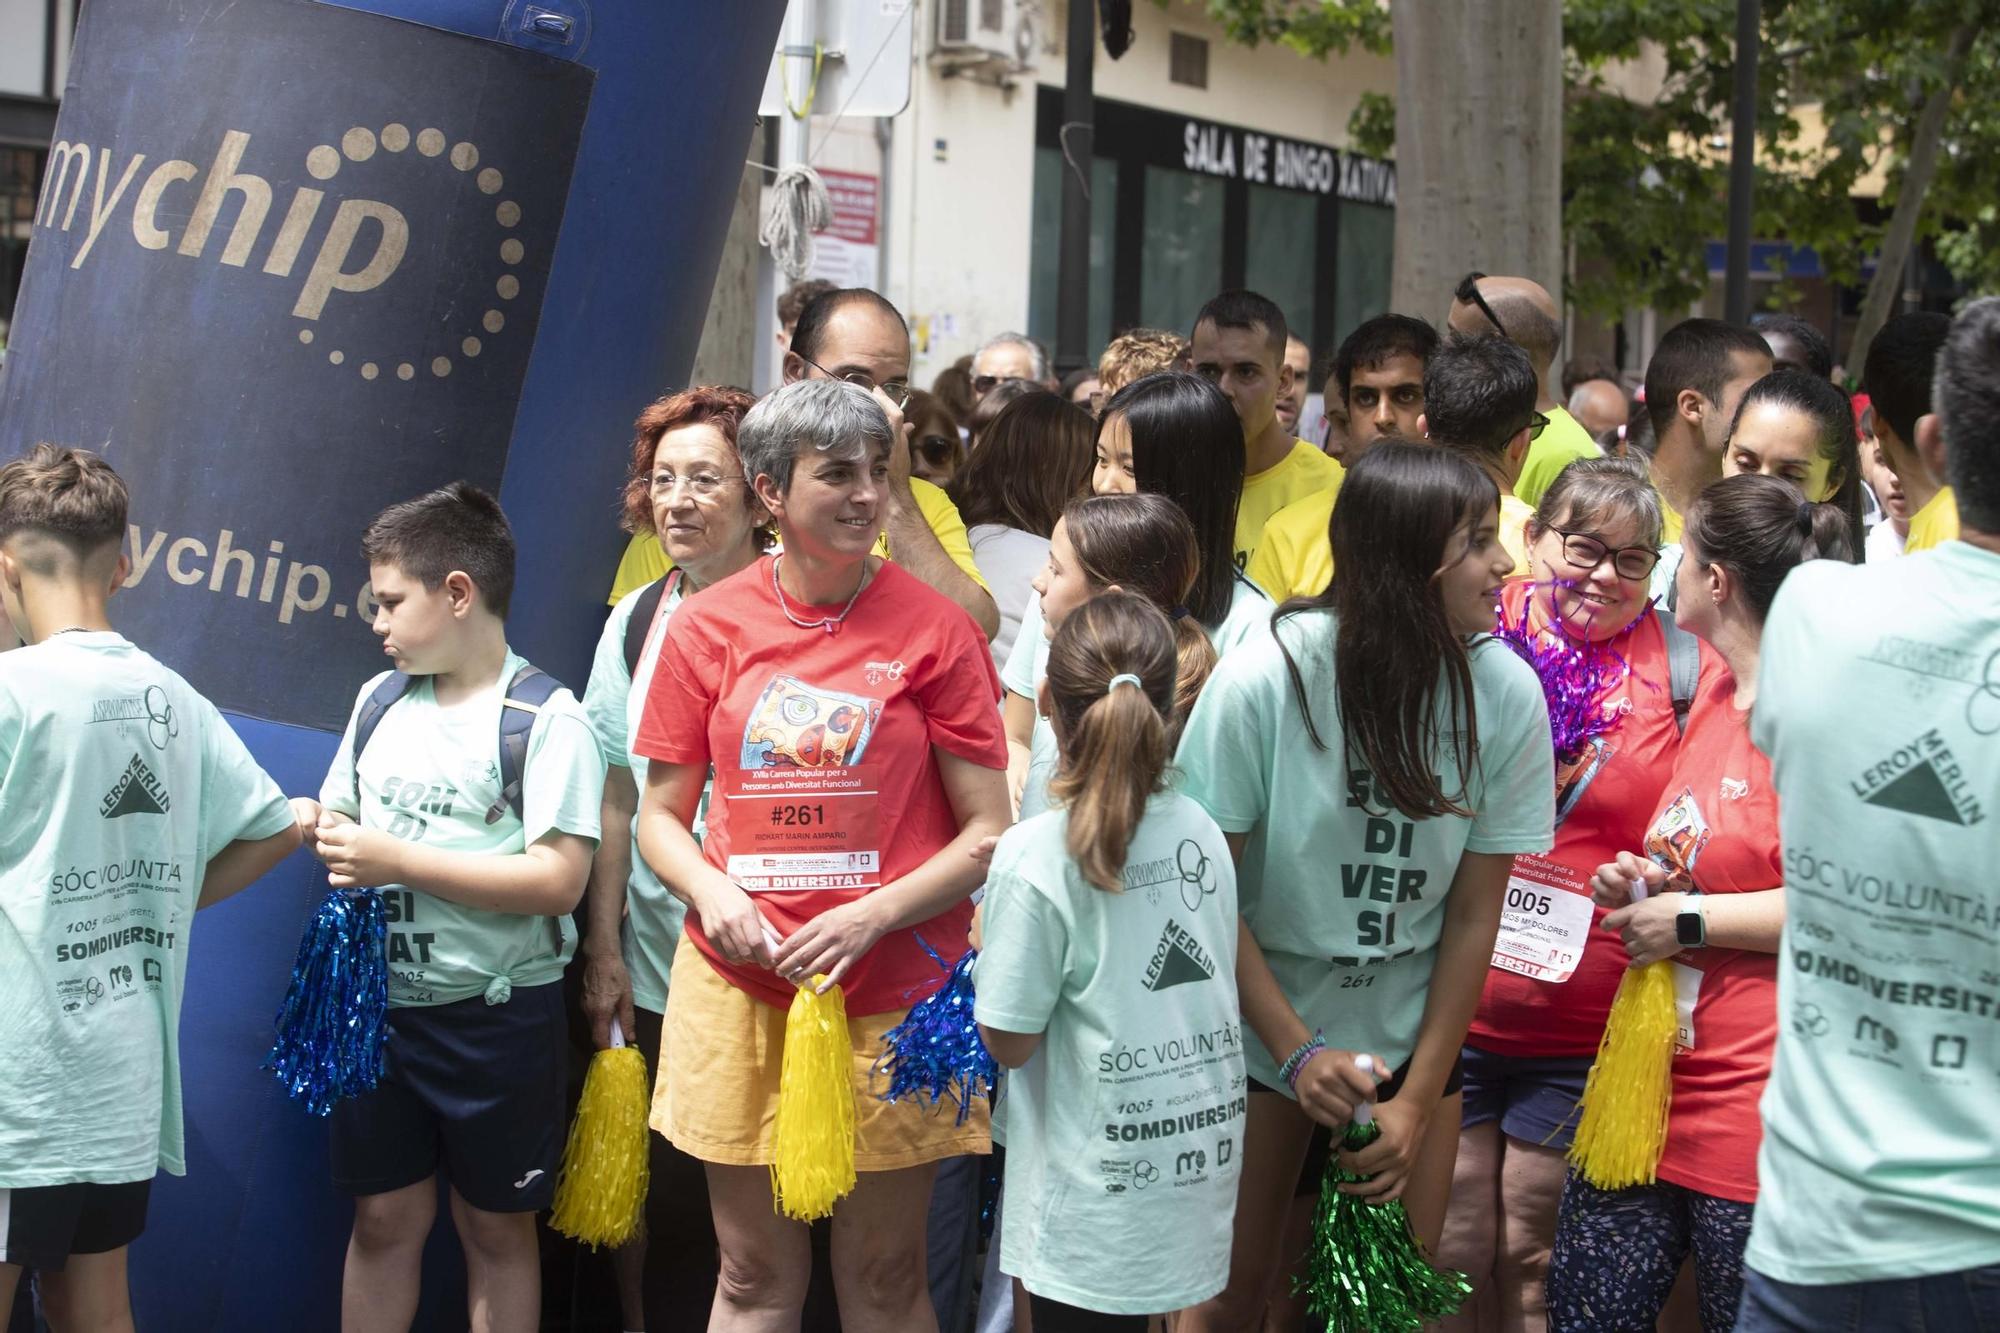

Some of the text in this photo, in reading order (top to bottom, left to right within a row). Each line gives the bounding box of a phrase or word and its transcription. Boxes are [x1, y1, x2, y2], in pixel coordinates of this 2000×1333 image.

[1184, 121, 1237, 178] SALA
[1243, 133, 1268, 183] DE
[1274, 140, 1334, 193] BINGO
[36, 129, 410, 321] mychip
[130, 752, 171, 813] MERLIN
[770, 770, 795, 778] Carrera
[796, 768, 825, 779] Popular
[827, 770, 841, 778] per
[1850, 739, 1924, 797] LEROY
[1922, 728, 1987, 826] MERLIN
[100, 764, 133, 817] LEROY
[380, 776, 459, 817] SOM
[741, 779, 862, 791] Persones amb Diversitat Funcional
[771, 805, 825, 826] #261
[812, 831, 846, 840] AMPARO
[1364, 817, 1414, 858] DI
[51, 866, 97, 895] SÓC
[1524, 855, 1555, 870] Popular
[1554, 865, 1568, 874] per
[1786, 847, 1836, 888] SÓC
[773, 875, 863, 887] DIVERSITAT
[1341, 864, 1427, 903] VER
[1547, 873, 1585, 890] Funcional
[1507, 888, 1552, 915] 005
[1357, 910, 1396, 946] SI
[1531, 920, 1569, 937] DOLORES
[1141, 931, 1171, 989] LEROY
[1165, 918, 1216, 977] MERLIN
[1340, 974, 1376, 988] 261
[1099, 1045, 1148, 1073] SÓC
[1114, 1075, 1145, 1084] CARRERA
[1105, 1097, 1246, 1142] SOMDIVERSITA
[1117, 1099, 1154, 1115] 1005
